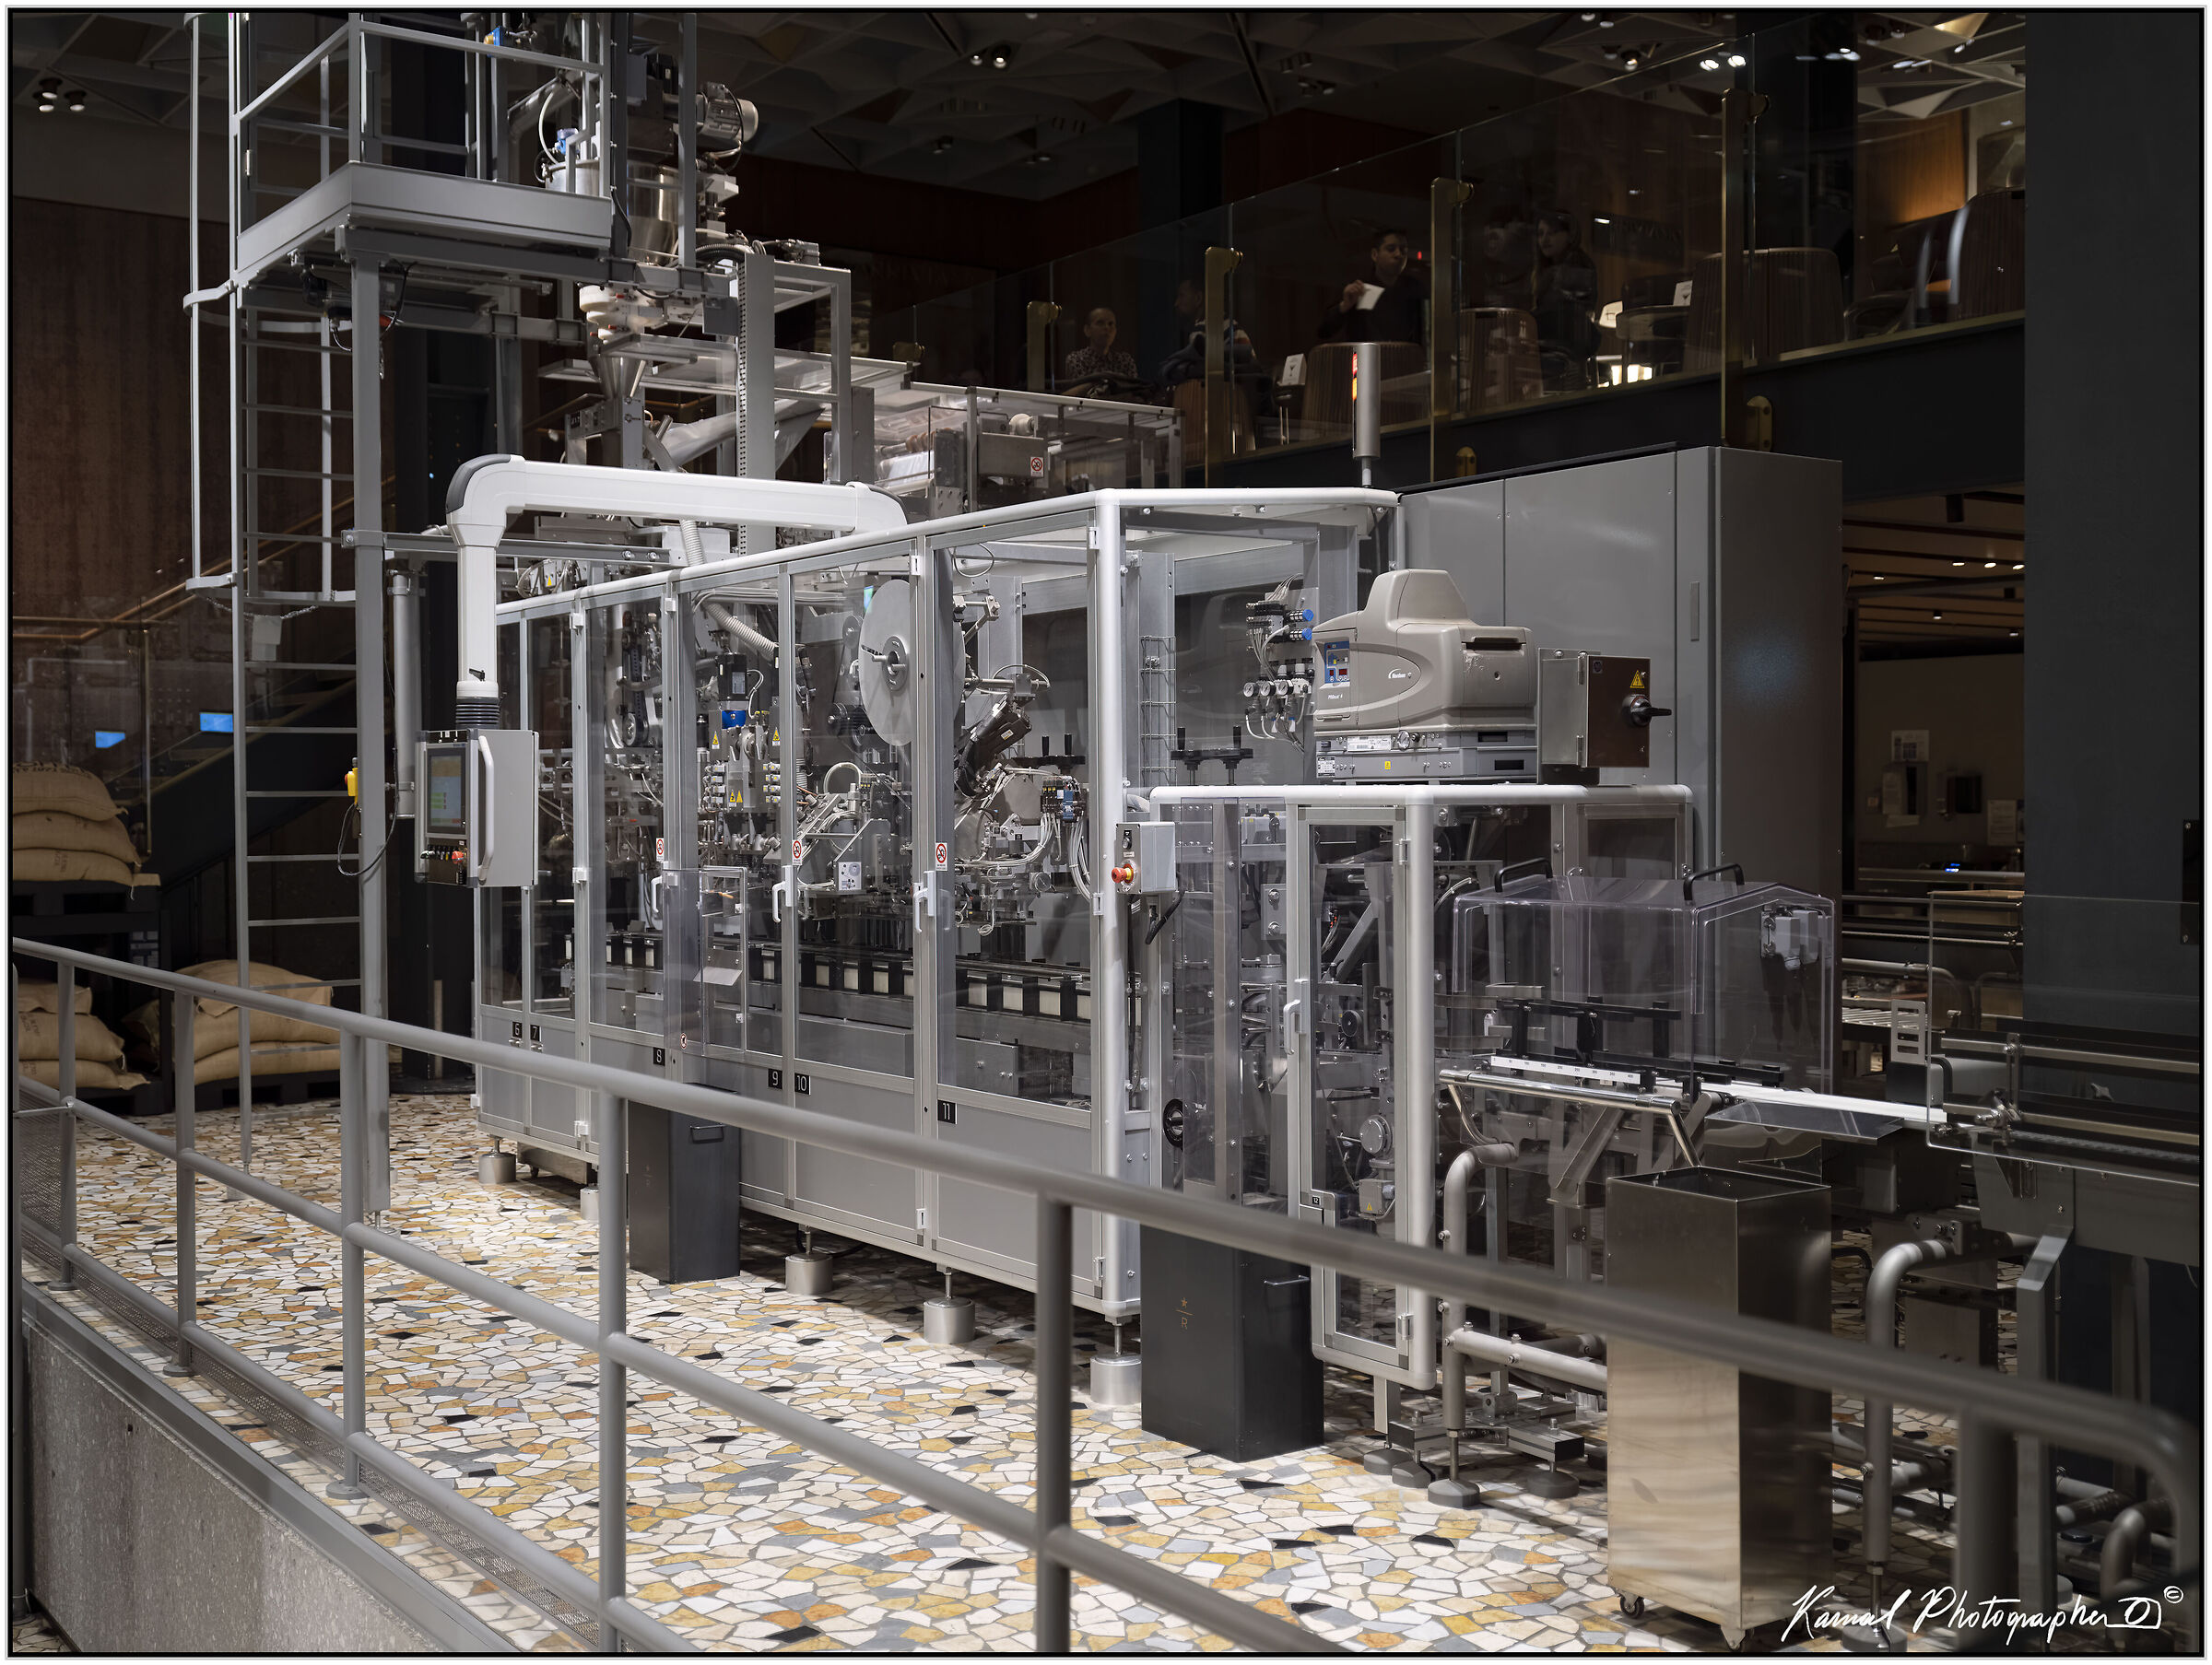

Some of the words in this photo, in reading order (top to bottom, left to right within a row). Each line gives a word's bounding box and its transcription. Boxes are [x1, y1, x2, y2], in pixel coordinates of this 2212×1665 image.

[514, 1023, 520, 1036] 6
[532, 1026, 537, 1038] 7
[656, 1049, 662, 1063] 8
[772, 1071, 779, 1086] 9
[796, 1074, 807, 1091] 10
[942, 1102, 950, 1120] 11
